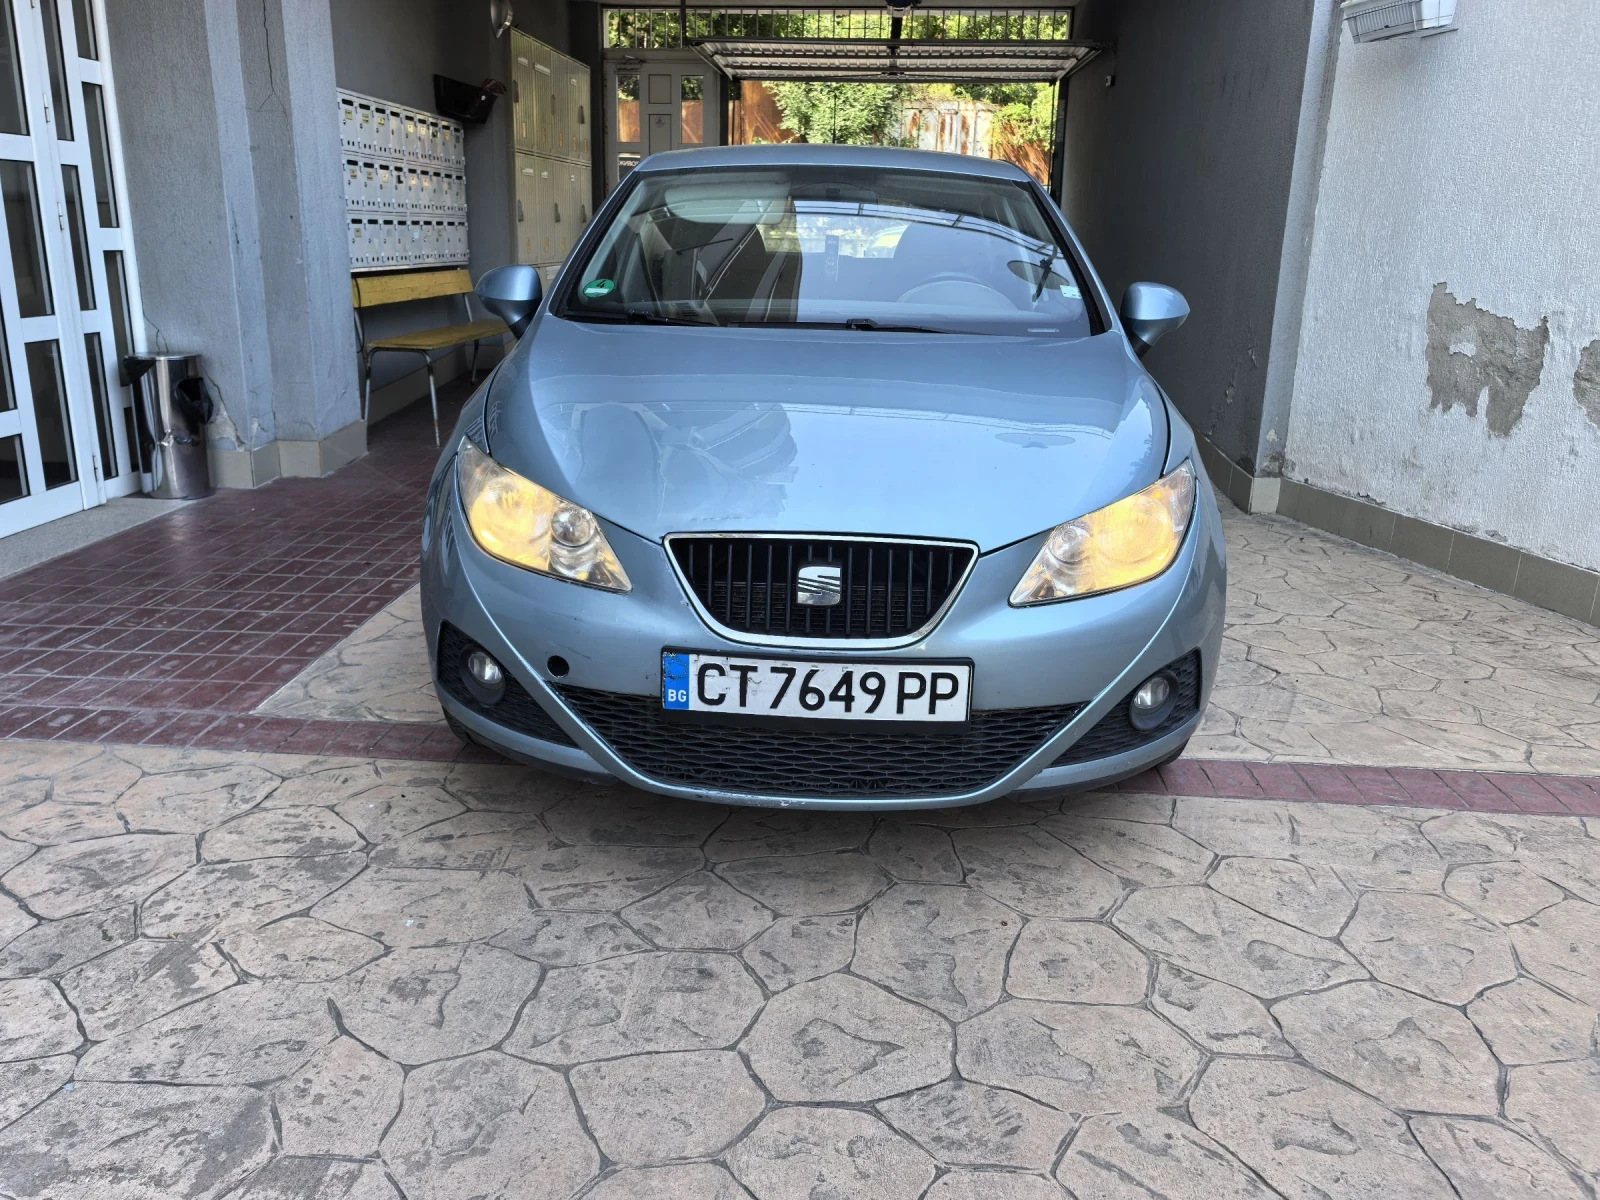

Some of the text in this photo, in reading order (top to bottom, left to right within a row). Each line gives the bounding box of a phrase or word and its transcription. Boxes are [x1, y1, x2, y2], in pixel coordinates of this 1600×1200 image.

[595, 279, 607, 289] 4
[667, 688, 687, 703] BG
[769, 666, 886, 714] 7649
